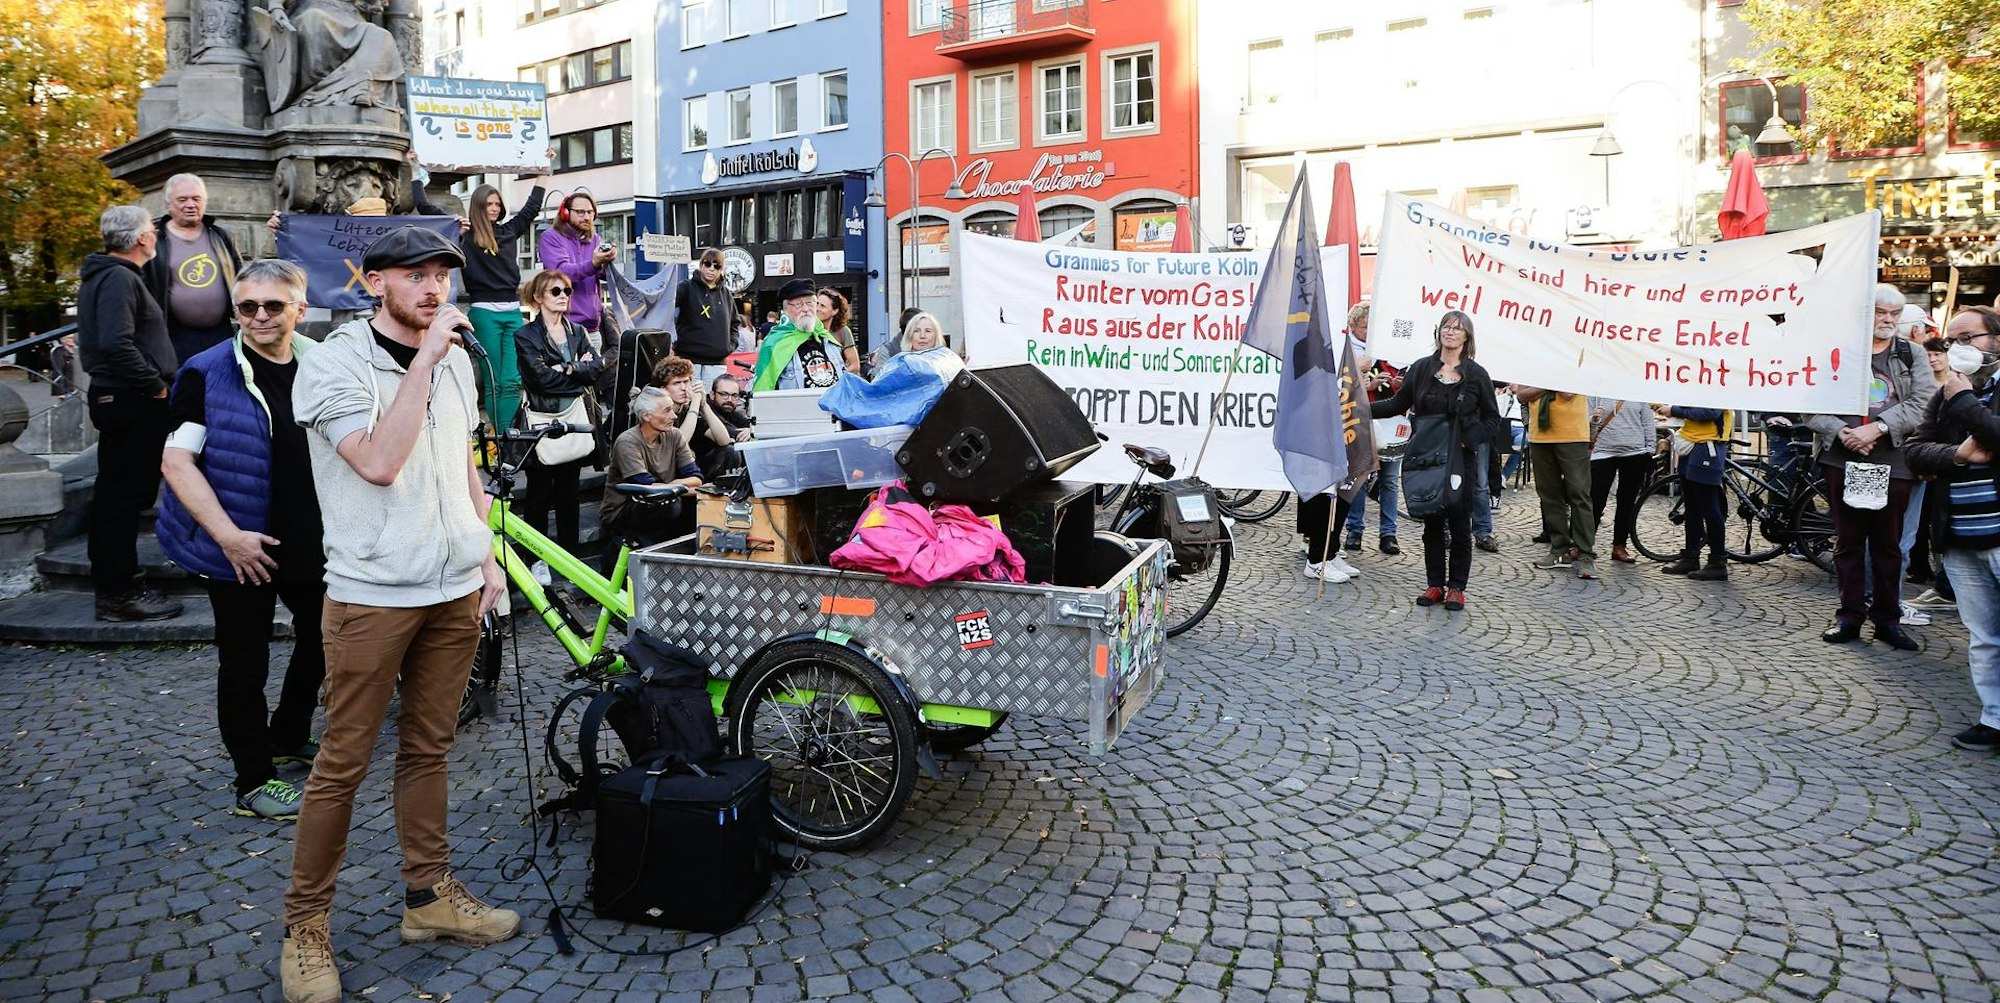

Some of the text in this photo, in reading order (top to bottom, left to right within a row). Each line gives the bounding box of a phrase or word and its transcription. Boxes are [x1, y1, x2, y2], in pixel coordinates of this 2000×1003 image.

[410, 78, 534, 101] What do you buy
[414, 99, 543, 122] when all the food
[454, 119, 470, 133] is
[476, 122, 512, 141] gone
[719, 147, 798, 177] Gaffel Kölsch
[957, 153, 1106, 198] Chocolaterie
[1046, 250, 1258, 276] Grannies for Future Köln
[1462, 244, 1507, 274] Wir
[1518, 266, 1565, 288] sind
[1584, 274, 1636, 298] hier
[1646, 283, 1686, 303] und
[1700, 283, 1805, 306] empört,
[1056, 275, 1255, 307] Runter vom Gas!
[1042, 308, 1098, 336] Raus
[1105, 318, 1142, 338] aus
[1147, 314, 1186, 340] der
[1421, 283, 1750, 347] weil man unsere Enkel
[1027, 340, 1066, 367] Rein
[1071, 348, 1084, 366] in
[1142, 347, 1169, 372] und
[1645, 358, 1731, 387] nicht
[1139, 391, 1199, 426] DEN
[957, 617, 990, 633] FCK
[959, 629, 993, 644] NZS
